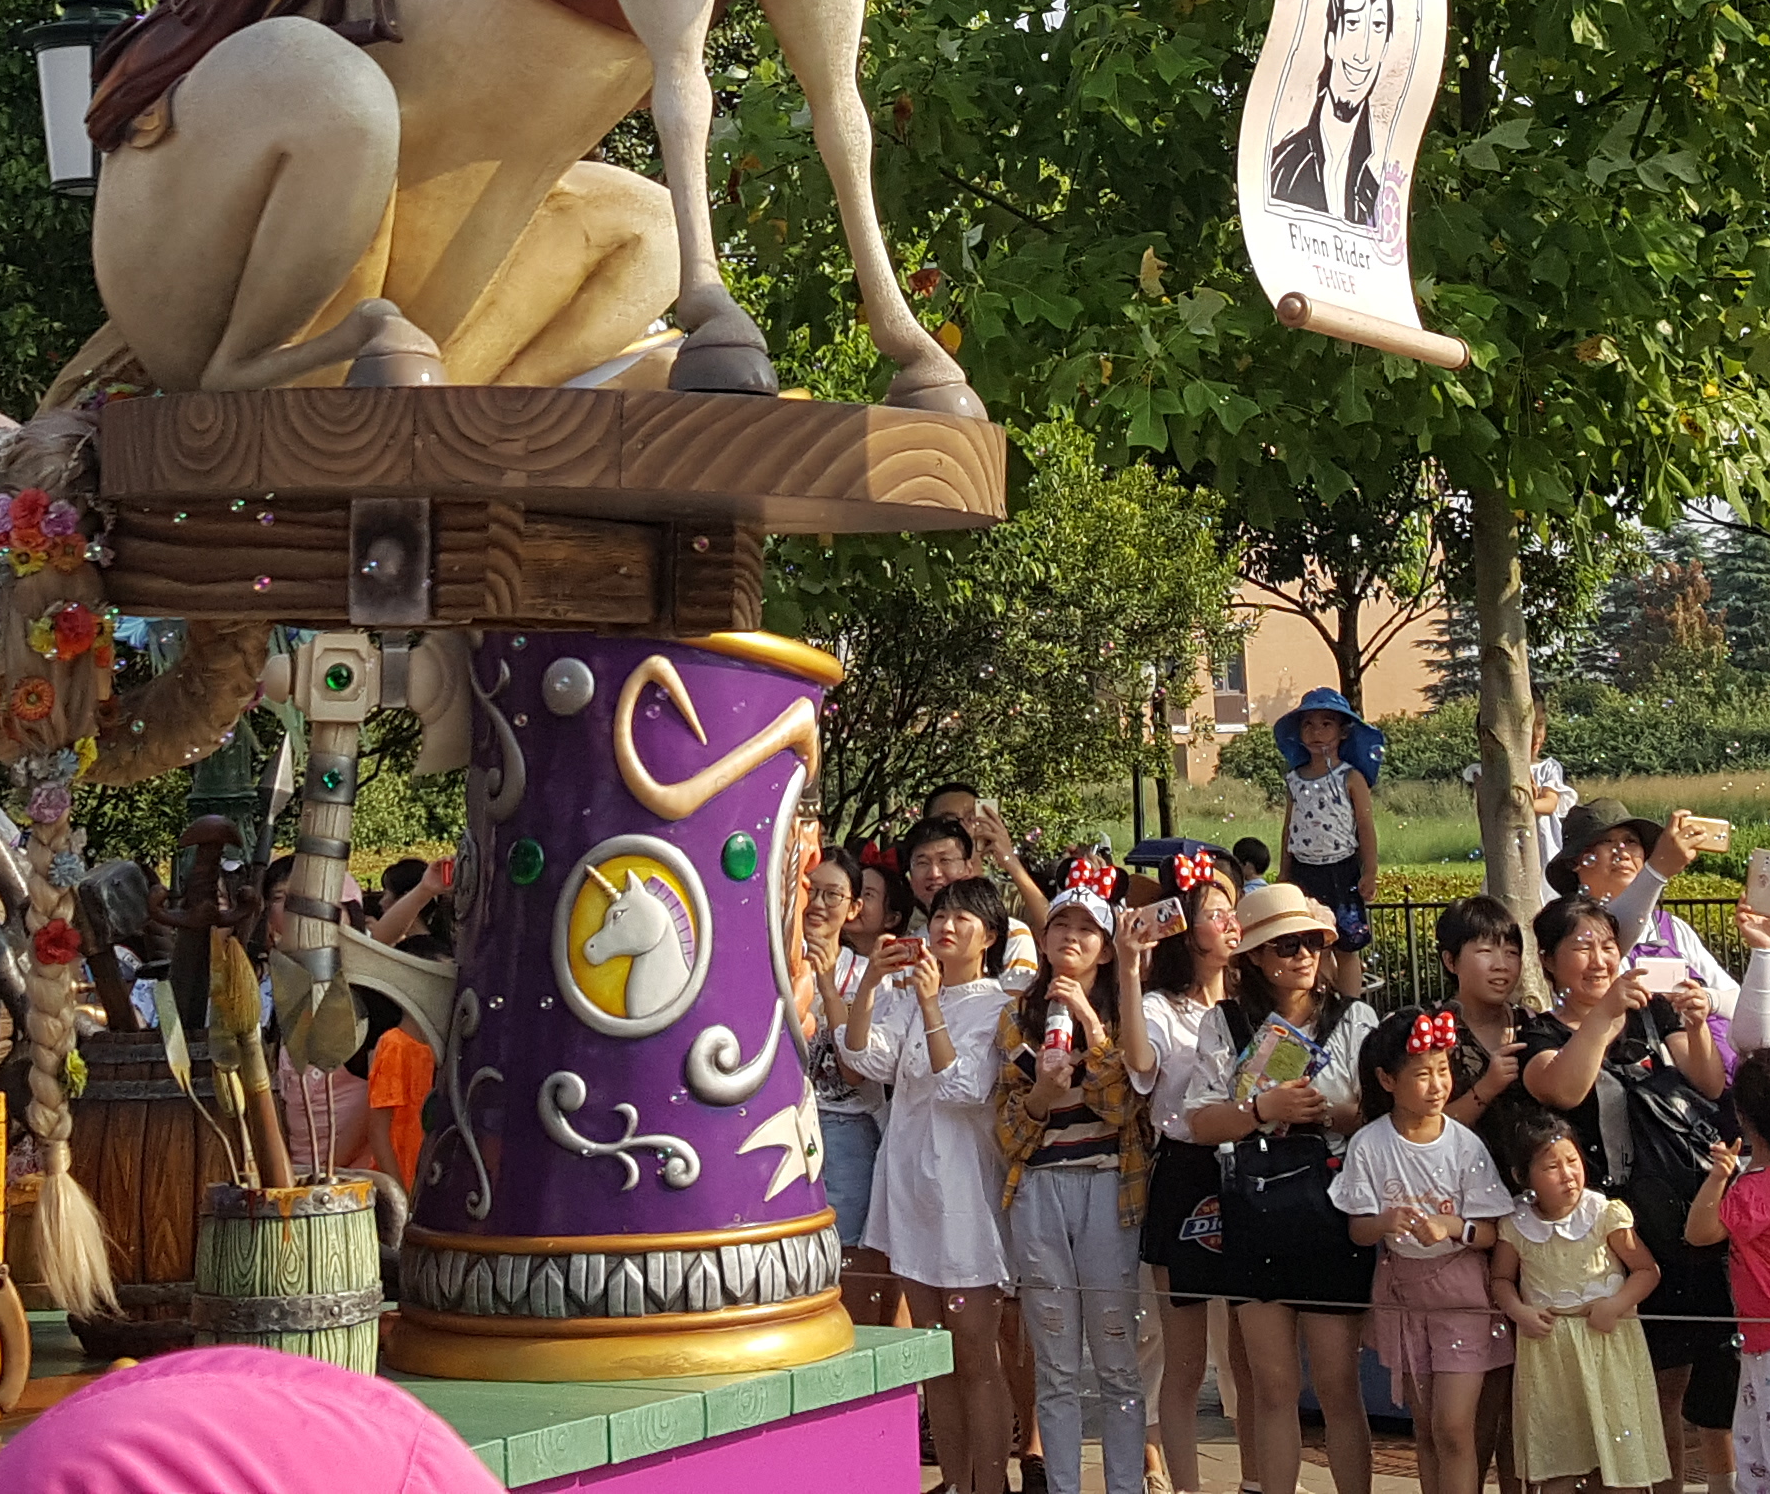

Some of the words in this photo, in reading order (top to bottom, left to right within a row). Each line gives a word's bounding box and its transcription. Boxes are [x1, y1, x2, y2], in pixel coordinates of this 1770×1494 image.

[1288, 222, 1330, 260] Flynn
[1333, 234, 1371, 270] Rider
[1312, 264, 1356, 295] THIEF
